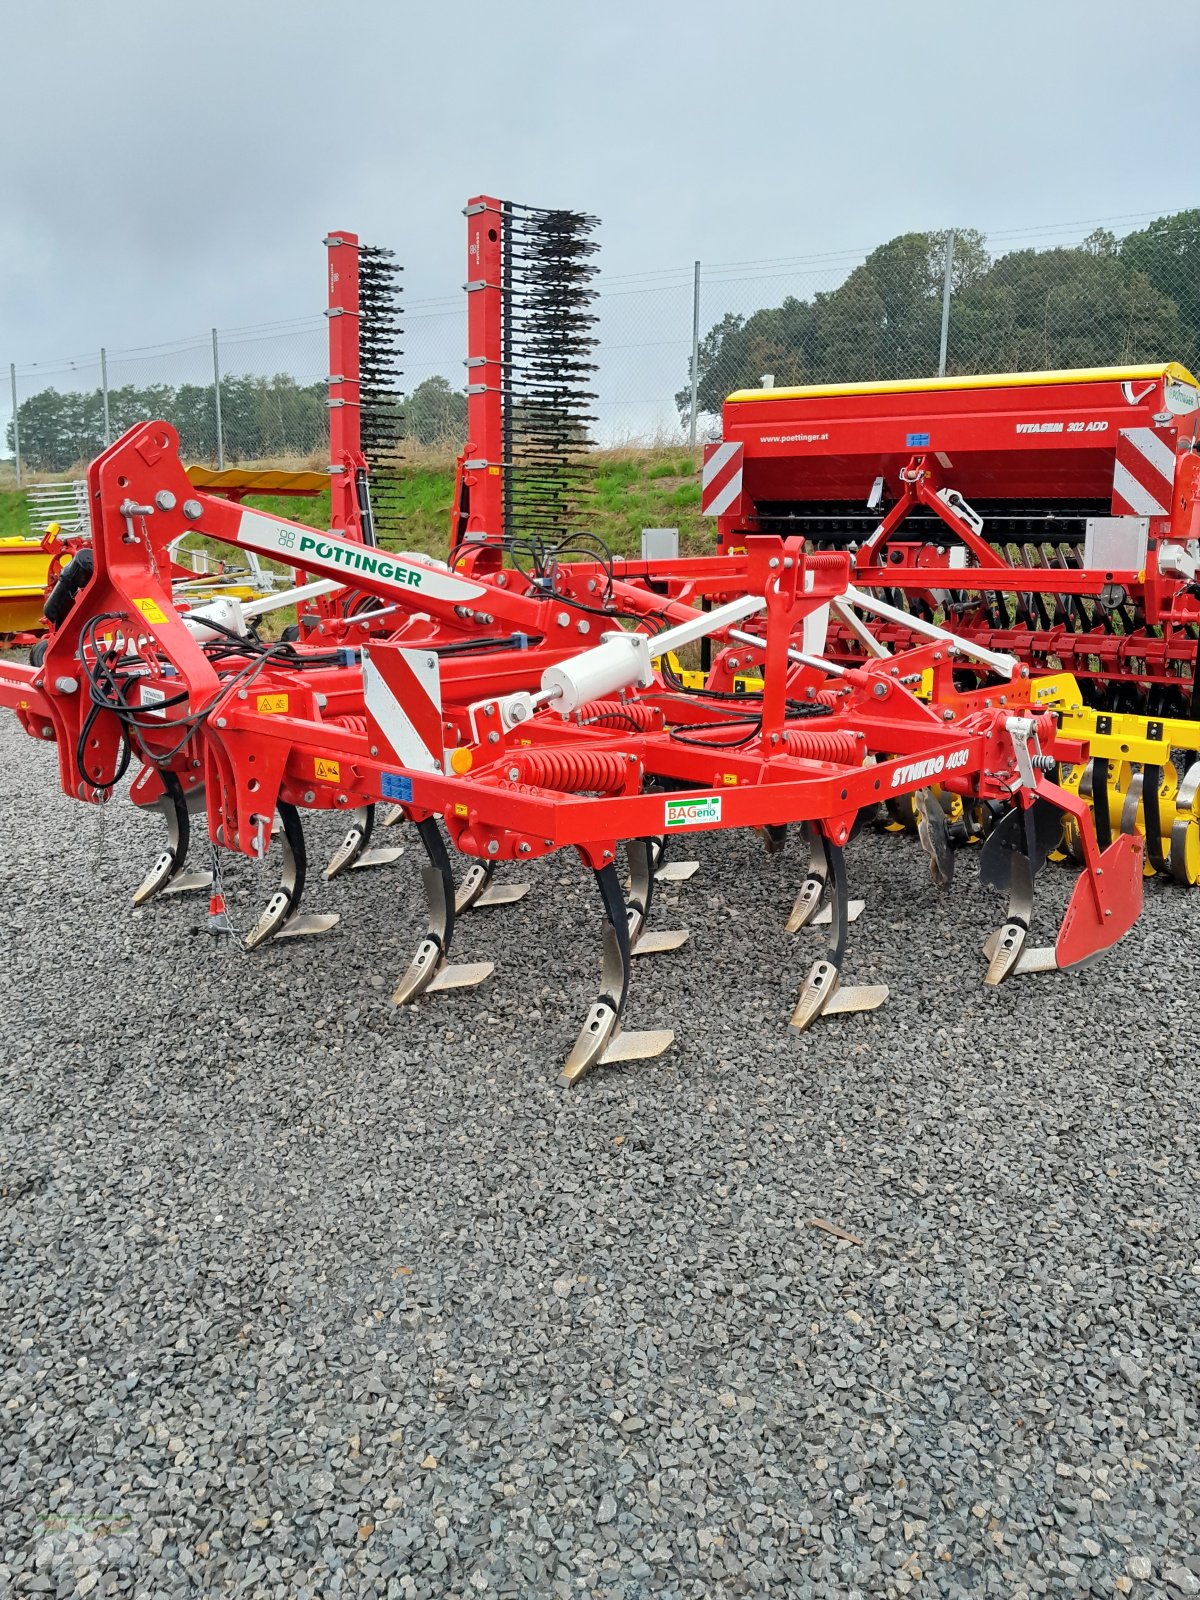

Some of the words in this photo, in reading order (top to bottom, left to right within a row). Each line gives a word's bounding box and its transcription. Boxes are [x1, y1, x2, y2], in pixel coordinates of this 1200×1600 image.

[1016, 423, 1064, 434] VITASEM
[1066, 422, 1085, 432] 302
[1085, 421, 1109, 432] ADD
[760, 433, 829, 443] www.poettinger.at
[891, 755, 945, 788] SYNKRO
[945, 749, 970, 770] 4030
[668, 806, 716, 820] BAGeno
